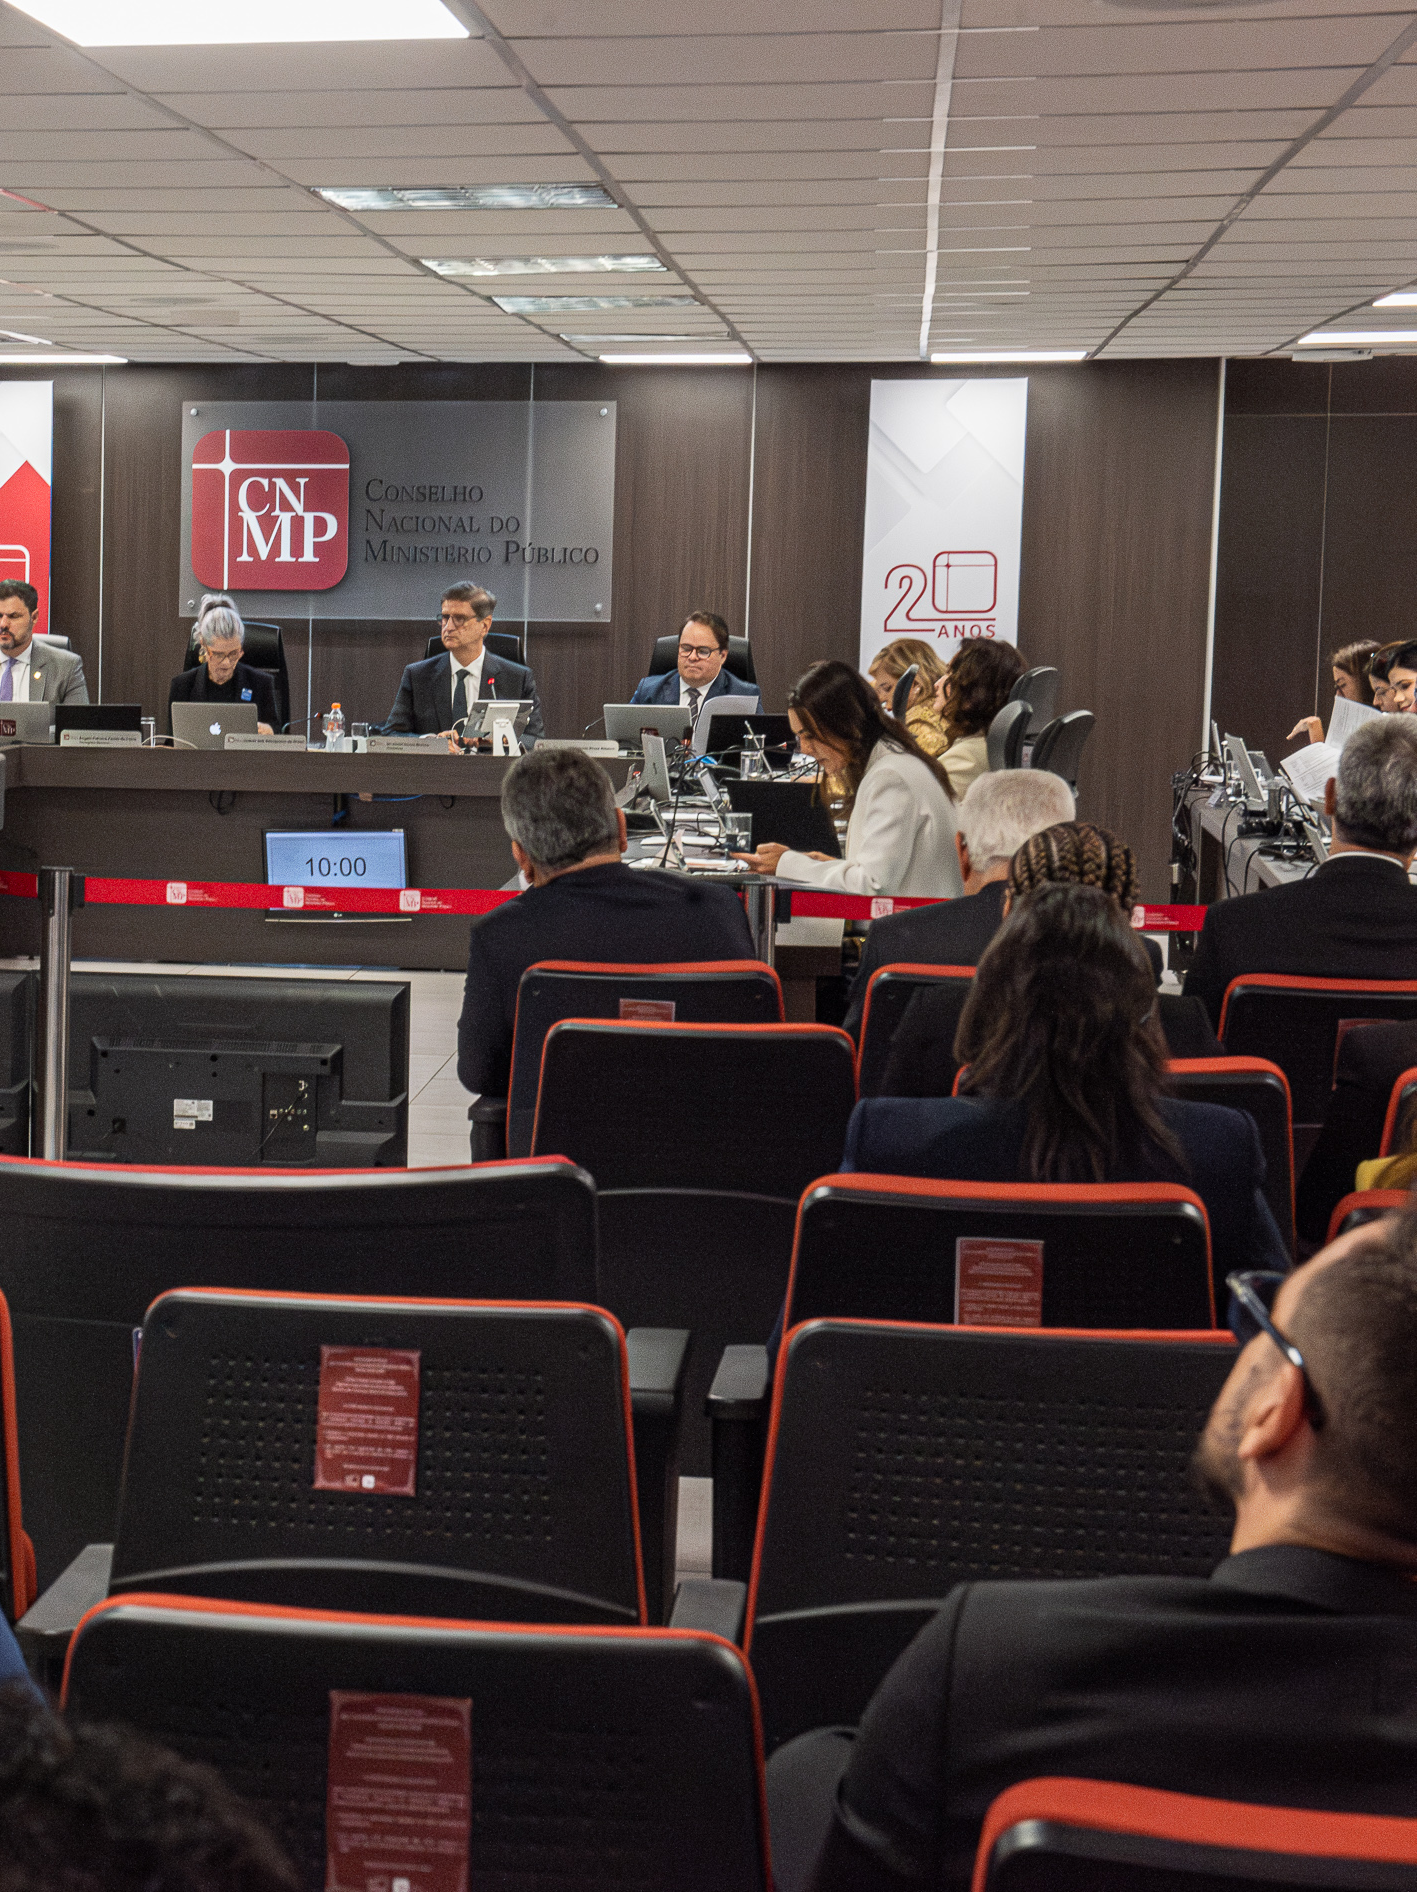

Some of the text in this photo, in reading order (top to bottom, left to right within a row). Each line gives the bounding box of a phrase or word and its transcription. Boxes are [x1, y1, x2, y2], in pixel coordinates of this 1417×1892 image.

[237, 477, 310, 516] CN
[236, 511, 339, 562] MP
[937, 624, 996, 639] ANOS
[305, 857, 367, 877] 10:00
